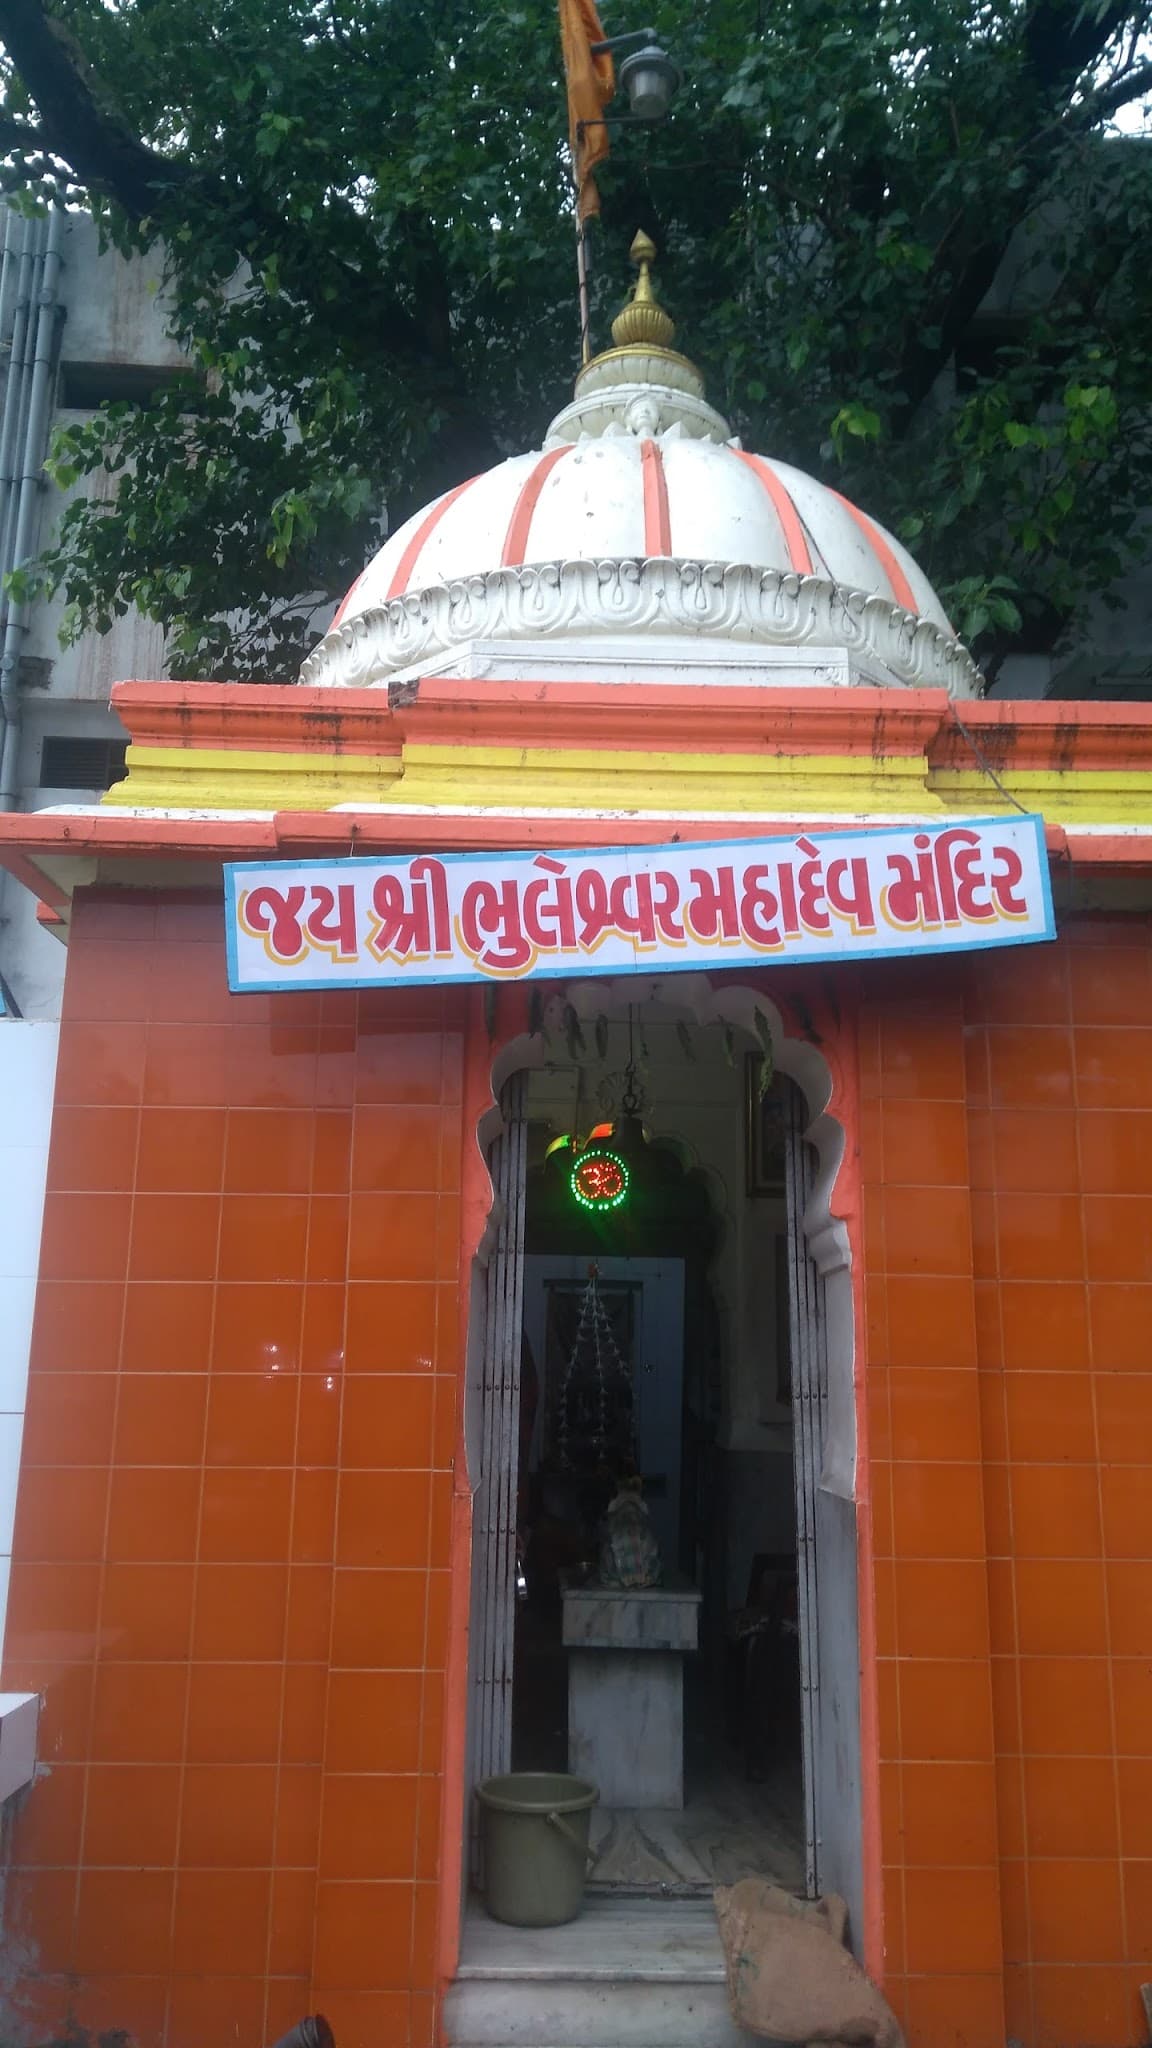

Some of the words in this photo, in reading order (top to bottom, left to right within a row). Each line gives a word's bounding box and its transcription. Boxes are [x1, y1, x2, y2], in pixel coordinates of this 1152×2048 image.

[241, 885, 358, 964] જય
[368, 857, 453, 963] શ્રી
[882, 829, 1029, 931] મંદિર
